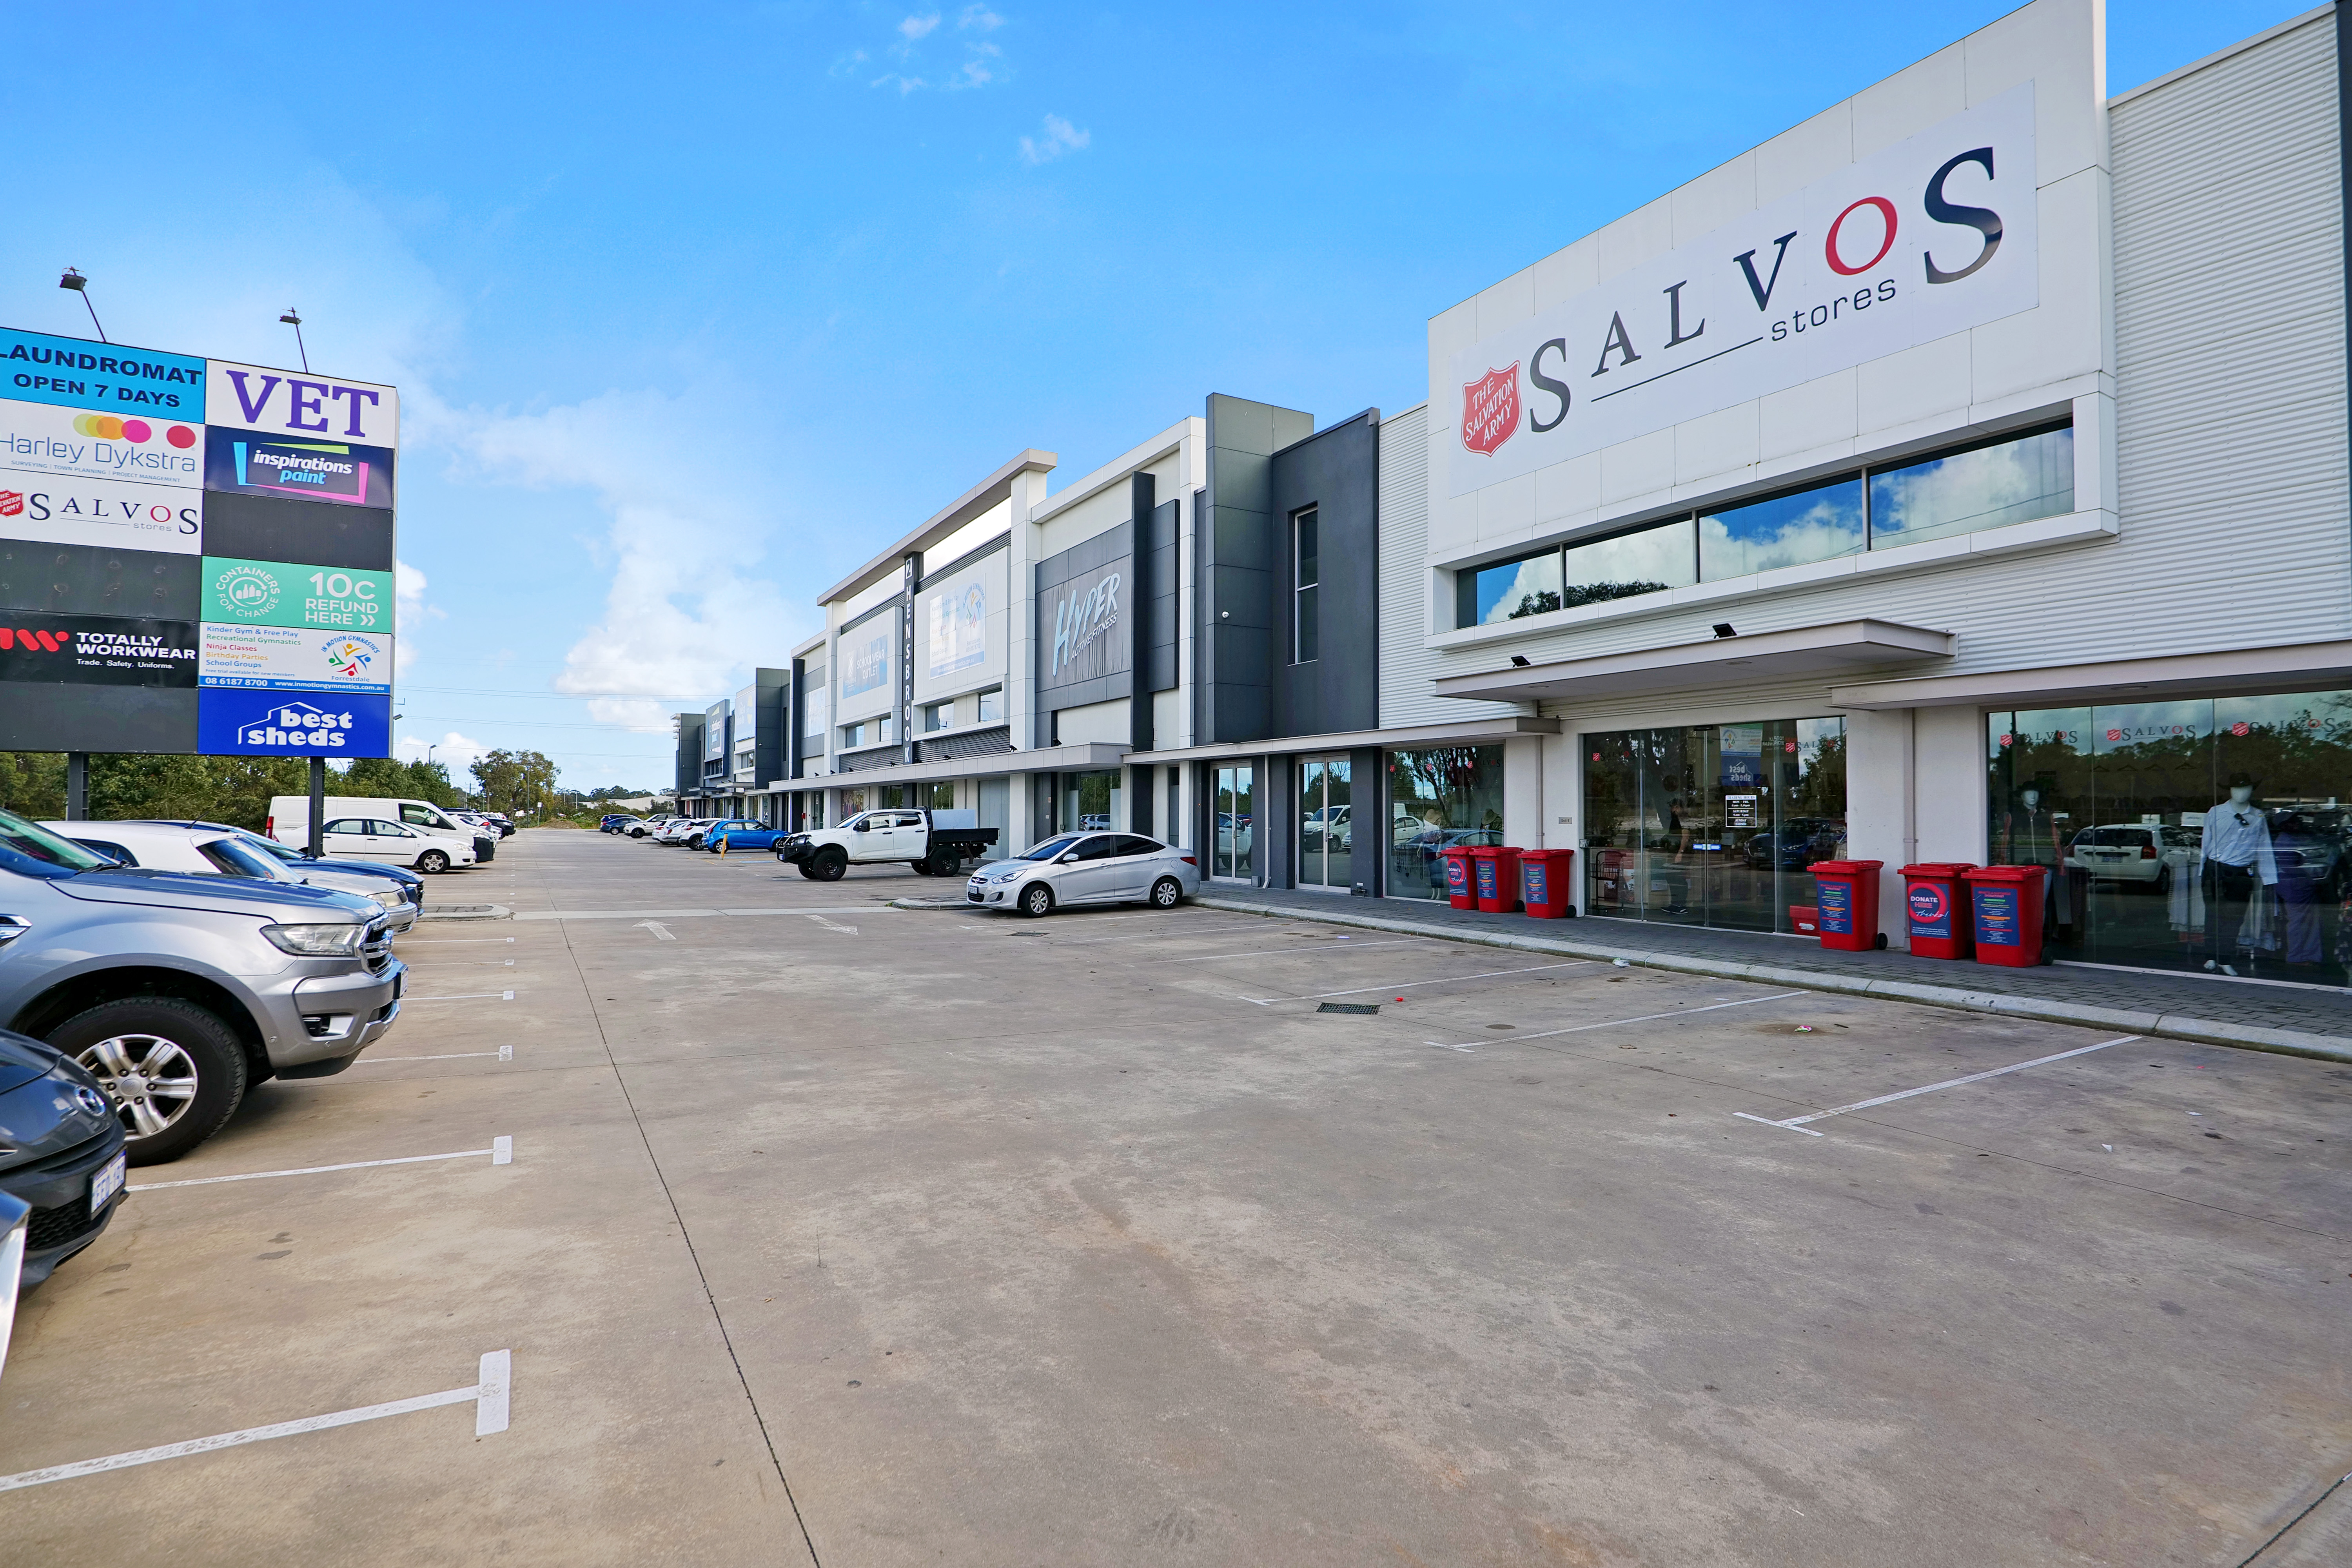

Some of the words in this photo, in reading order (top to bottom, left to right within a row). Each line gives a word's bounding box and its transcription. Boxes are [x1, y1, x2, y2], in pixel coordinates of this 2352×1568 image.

[1530, 146, 2004, 433] SALVOS
[1771, 278, 1896, 341] stores
[0, 344, 202, 385] AUNDROMAT
[13, 374, 85, 395] OPEN
[94, 384, 109, 397] 7
[118, 387, 180, 407] DAYS
[1473, 377, 1495, 410] THE
[226, 370, 379, 437] VET
[1466, 373, 1514, 441] SALVATION
[1483, 397, 1512, 446] ARMY
[96, 443, 195, 472] Dykstra
[253, 450, 353, 474] inspirations
[11, 460, 47, 468] SURVEYING
[74, 466, 106, 475] PLANNING
[139, 474, 181, 483] MANAGEMENT
[279, 469, 327, 485] paint
[2, 502, 20, 513] ARMY
[29, 493, 198, 534] SALVOS
[133, 523, 172, 532] stores
[906, 560, 911, 577] 2
[216, 567, 280, 594] CONTAINERS
[216, 593, 234, 612] FOR
[236, 597, 279, 617] CHANGE
[305, 598, 379, 613] REFUND
[305, 611, 353, 625] HERE
[1053, 573, 1120, 677] HYPER
[76, 632, 163, 646] TOTALLY
[326, 635, 346, 648] MOTION
[348, 635, 380, 653] GYMNASTICS
[1071, 632, 1092, 662] ACTIVE
[1091, 612, 1118, 641] FITNESS
[76, 643, 196, 660] WORKWEAR
[857, 649, 884, 669] SCHOOLWEAR
[107, 660, 134, 668] Safety.
[862, 665, 878, 679] OUTLET
[275, 681, 384, 691] www.inmotiongymnastics.com.au
[280, 709, 352, 729] best
[247, 727, 345, 746] sheds
[2122, 725, 2196, 741] SALVOS
[1915, 909, 1949, 919] Thanks!
